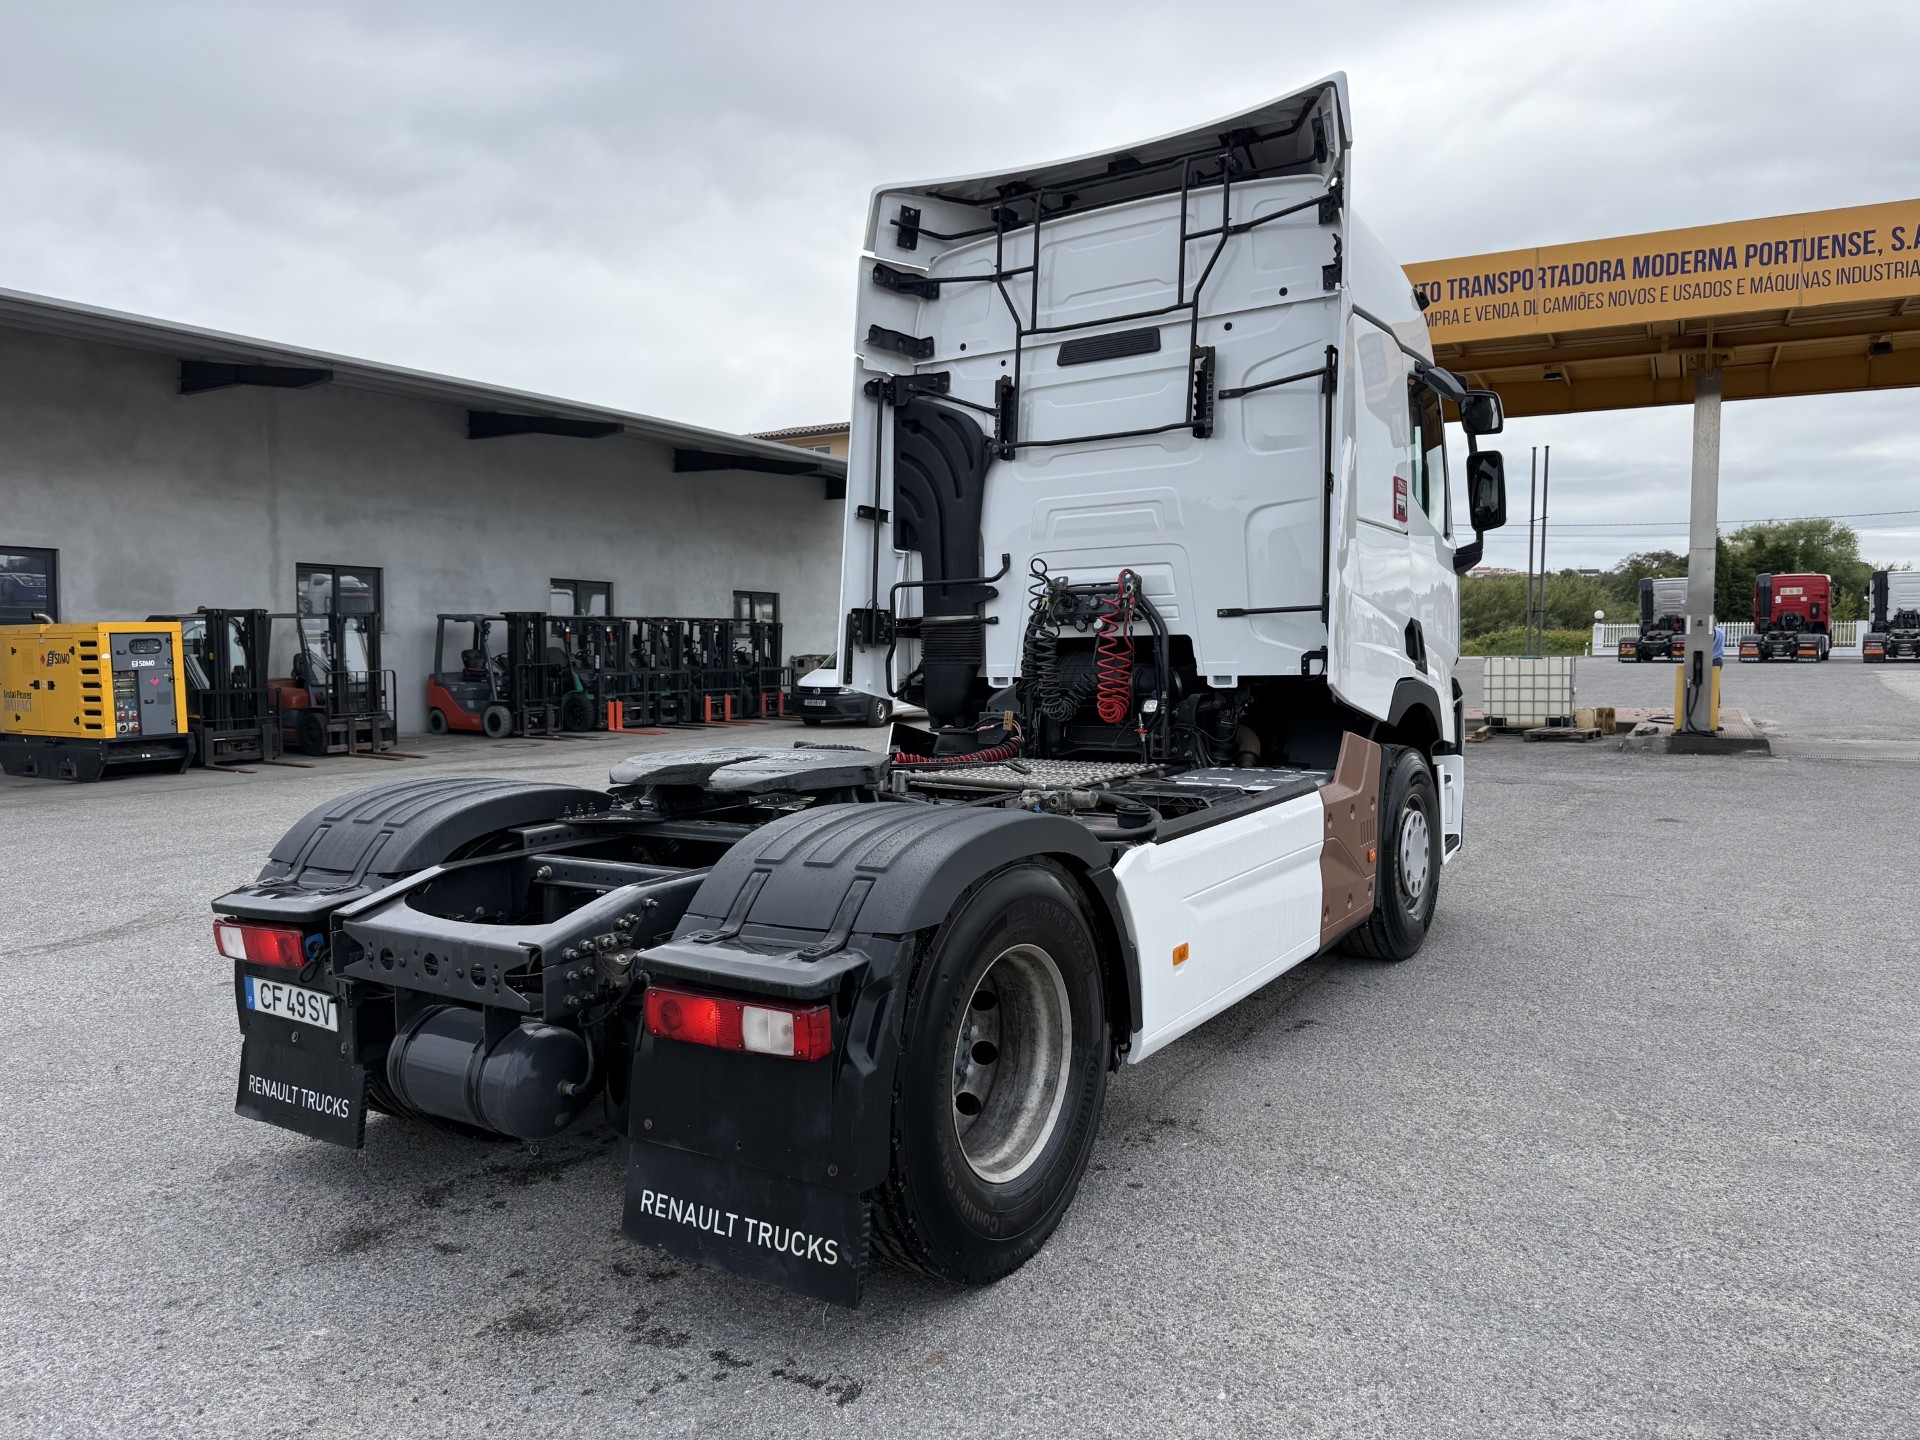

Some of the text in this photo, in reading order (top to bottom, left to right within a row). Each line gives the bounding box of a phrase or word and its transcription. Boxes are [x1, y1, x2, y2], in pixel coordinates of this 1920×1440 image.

[1447, 258, 1626, 300] TRANSPORTADORA
[1632, 245, 1738, 280] MODERNA
[1745, 229, 1883, 268] PORTUENSE,
[1463, 307, 1471, 323] E
[1475, 301, 1520, 322] VENDA
[1543, 291, 1605, 314] CAMIÕES
[1608, 287, 1656, 308] NOVOS
[1660, 285, 1669, 303] E
[1673, 279, 1732, 301] USADOS
[1737, 277, 1746, 295] E
[1750, 269, 1831, 294] MÁQUINAS
[248, 1074, 350, 1119] RENAULT TRUCKS
[640, 1189, 839, 1266] RENAULT TRUCKS
